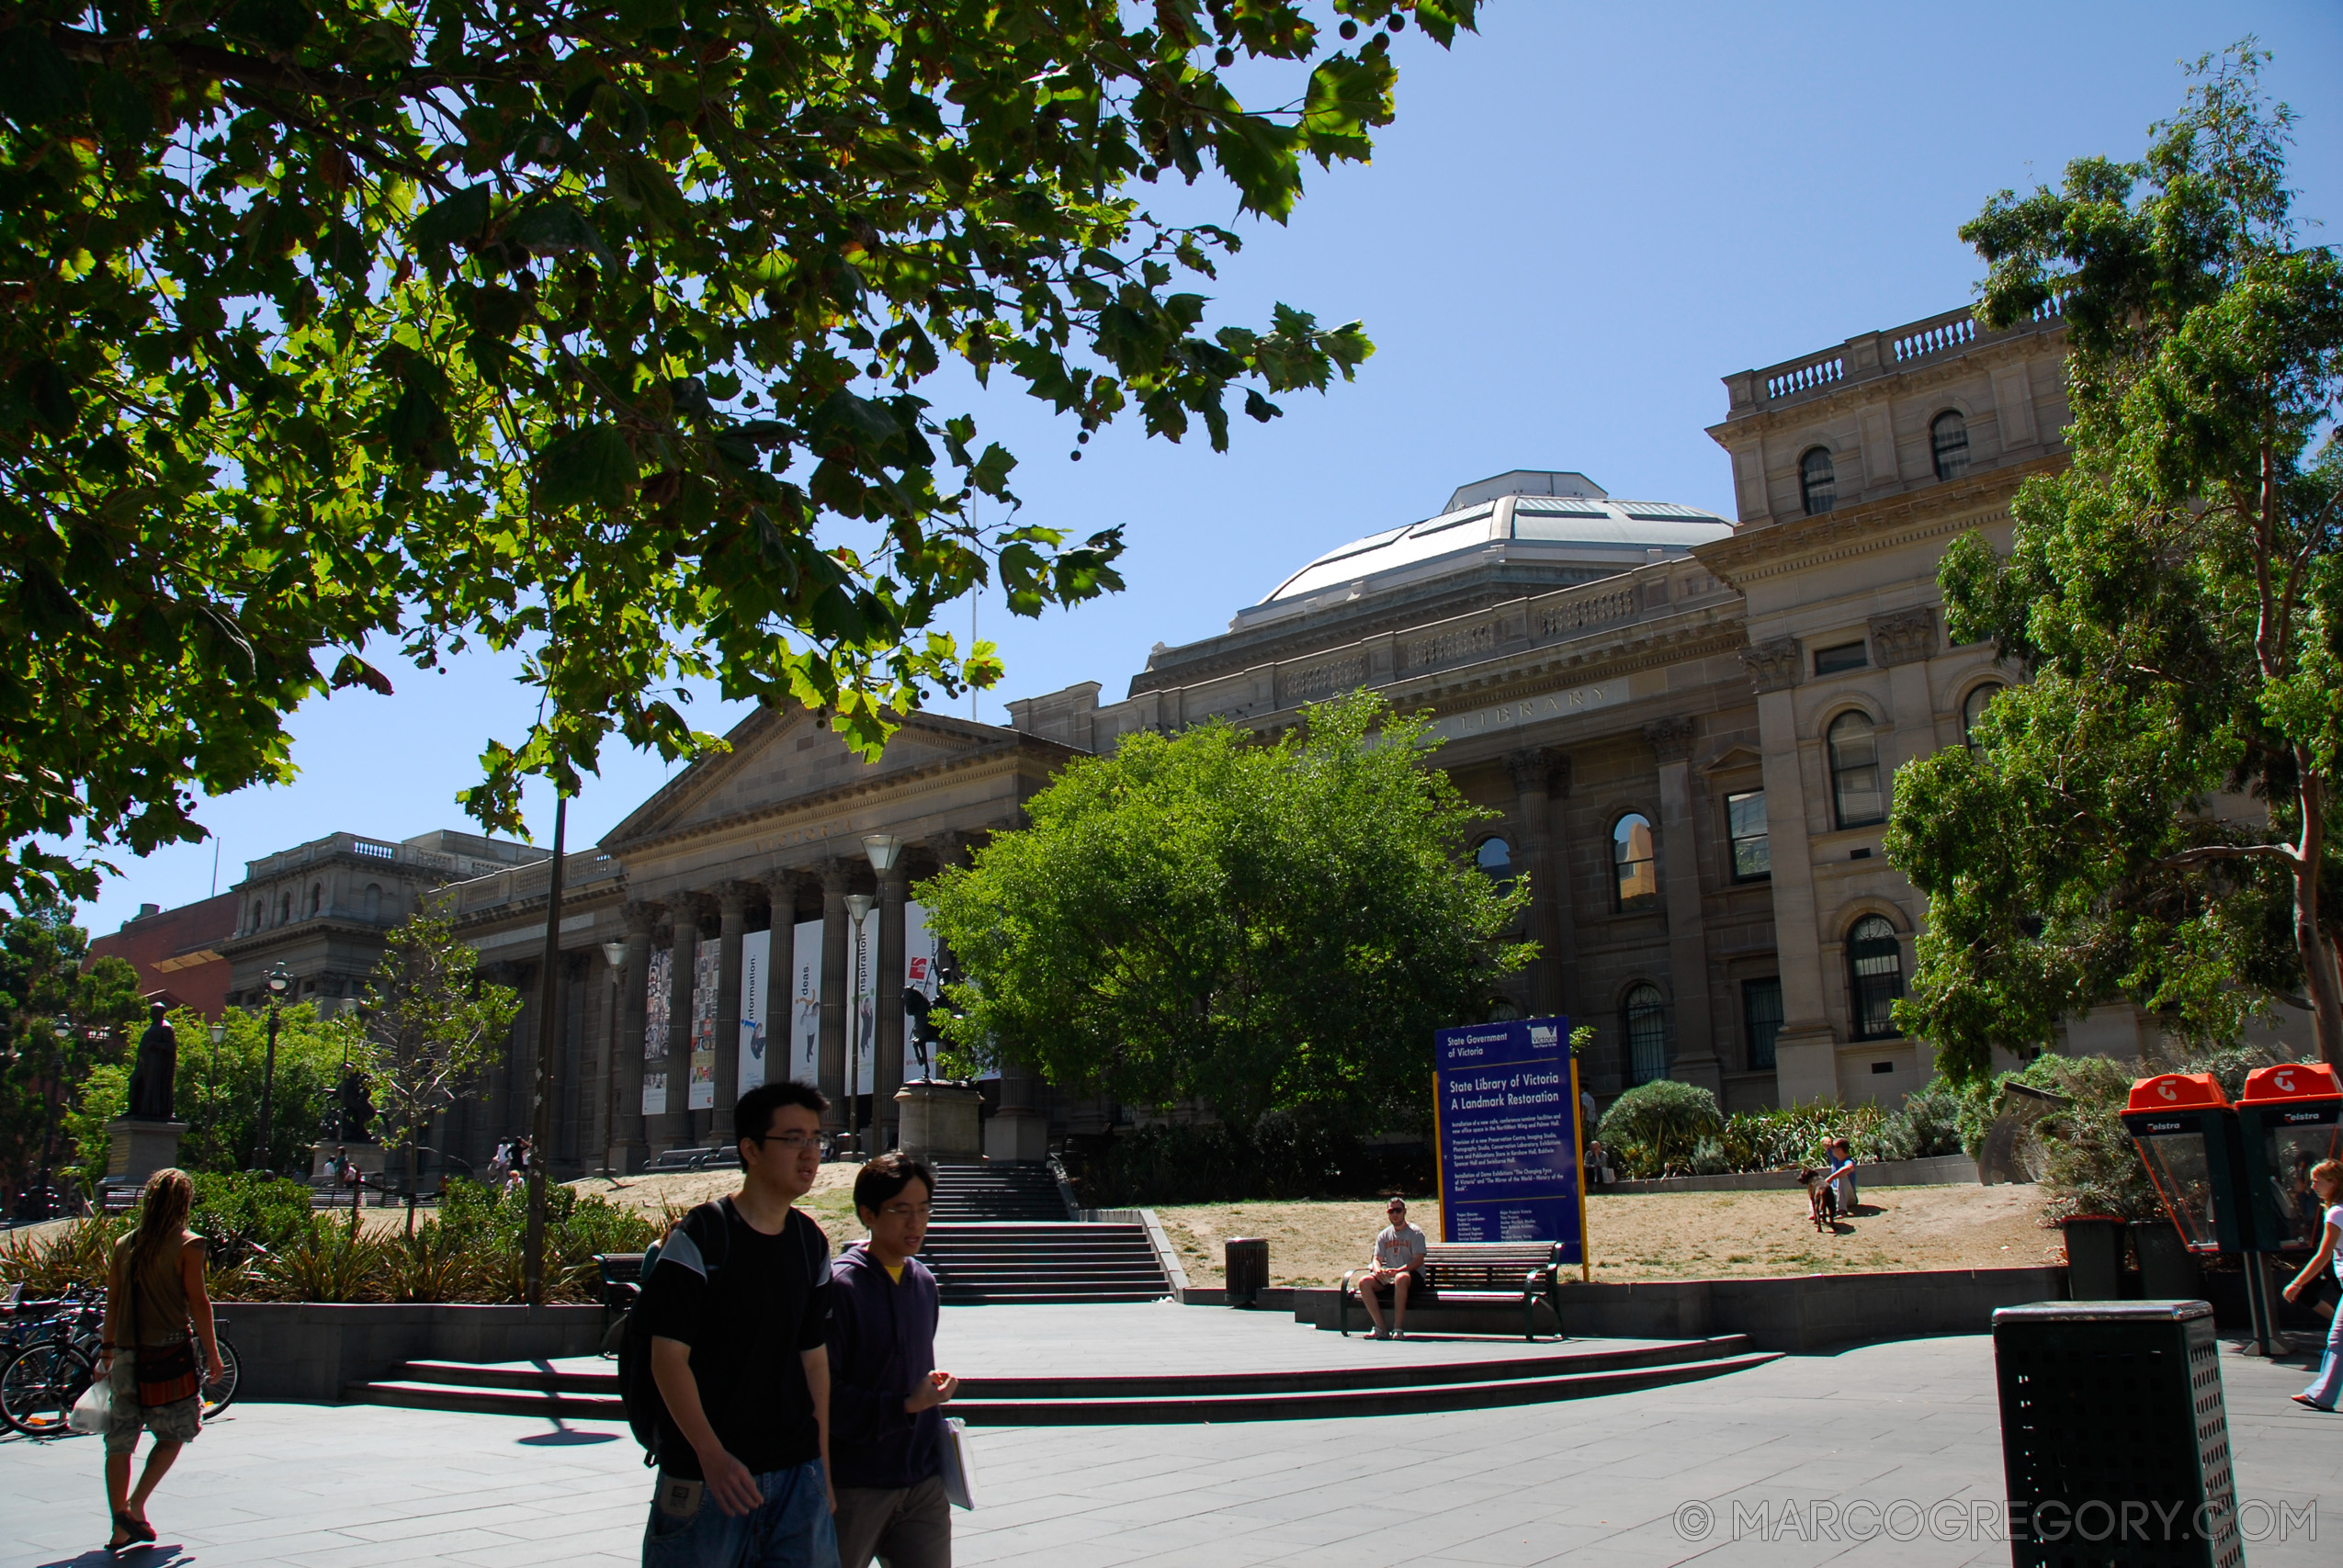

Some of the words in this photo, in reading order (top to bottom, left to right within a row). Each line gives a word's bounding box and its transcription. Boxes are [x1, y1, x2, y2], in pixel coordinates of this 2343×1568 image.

[1462, 685, 1608, 730] LIBRARY
[755, 818, 853, 852] VICTORIA
[1448, 1037, 1464, 1046] State
[1467, 1033, 1507, 1044] Government
[1448, 1048, 1455, 1058] of
[1457, 1046, 1483, 1057] Victoria
[1450, 1081, 1472, 1092] State
[1476, 1077, 1506, 1090] Library
[1510, 1074, 1519, 1087] of
[1523, 1072, 1558, 1086] Victoria
[1451, 1099, 1458, 1110] A
[1461, 1094, 1504, 1109] Landmark
[1508, 1091, 1558, 1105] Restoration
[2284, 1111, 2319, 1123] Telstra
[2146, 1122, 2180, 1133] Telstra
